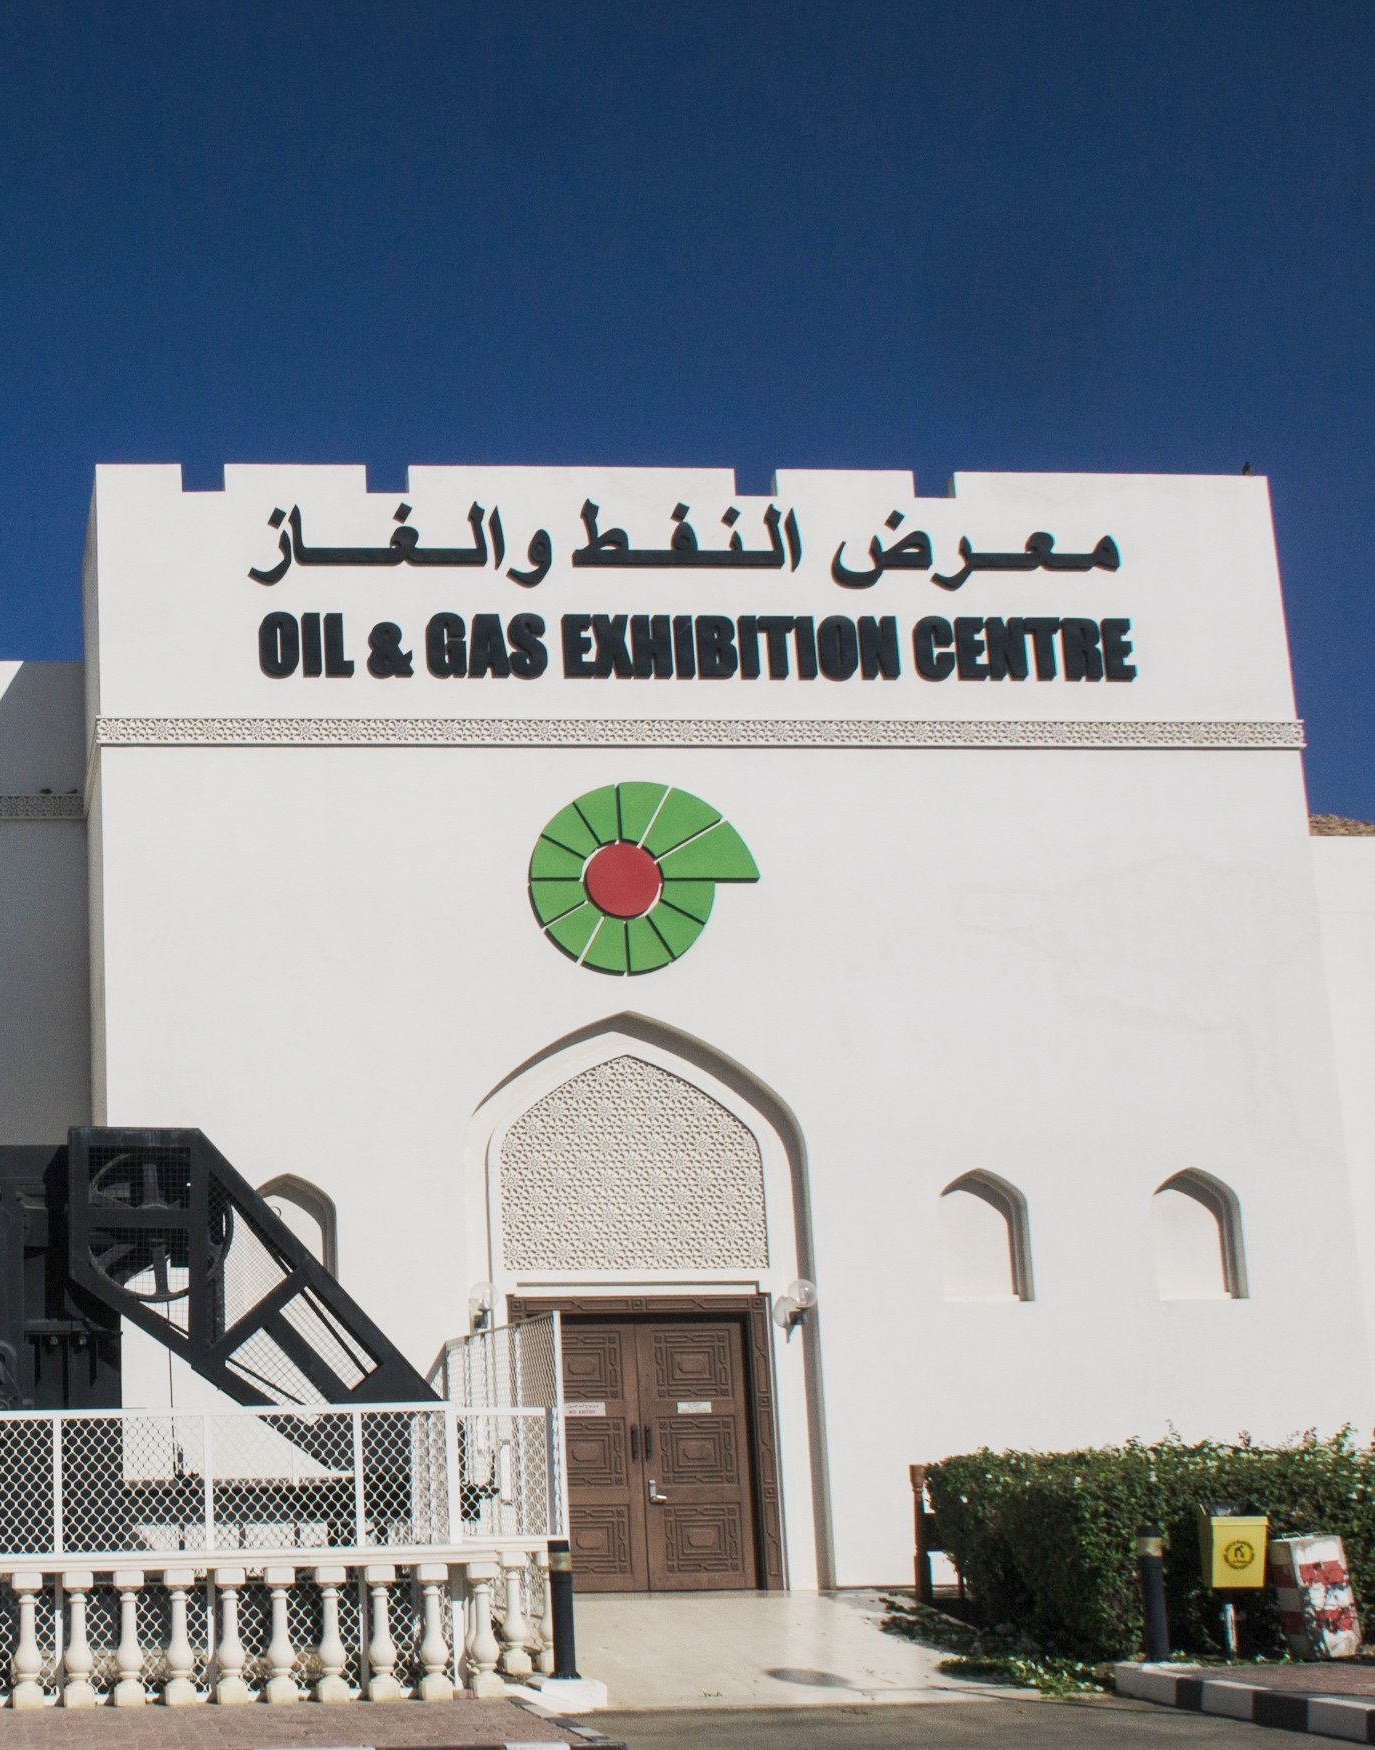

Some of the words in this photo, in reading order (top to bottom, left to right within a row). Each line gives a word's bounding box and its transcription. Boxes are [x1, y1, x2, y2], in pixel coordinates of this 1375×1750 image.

[247, 501, 553, 589] والغاز
[571, 498, 802, 572] النفط
[831, 508, 1120, 592] معرض
[258, 611, 355, 679] OIL
[366, 620, 414, 679] &
[425, 611, 548, 680] GAS
[560, 613, 901, 683] EXHIBITION
[912, 615, 1137, 684] CENTRE
